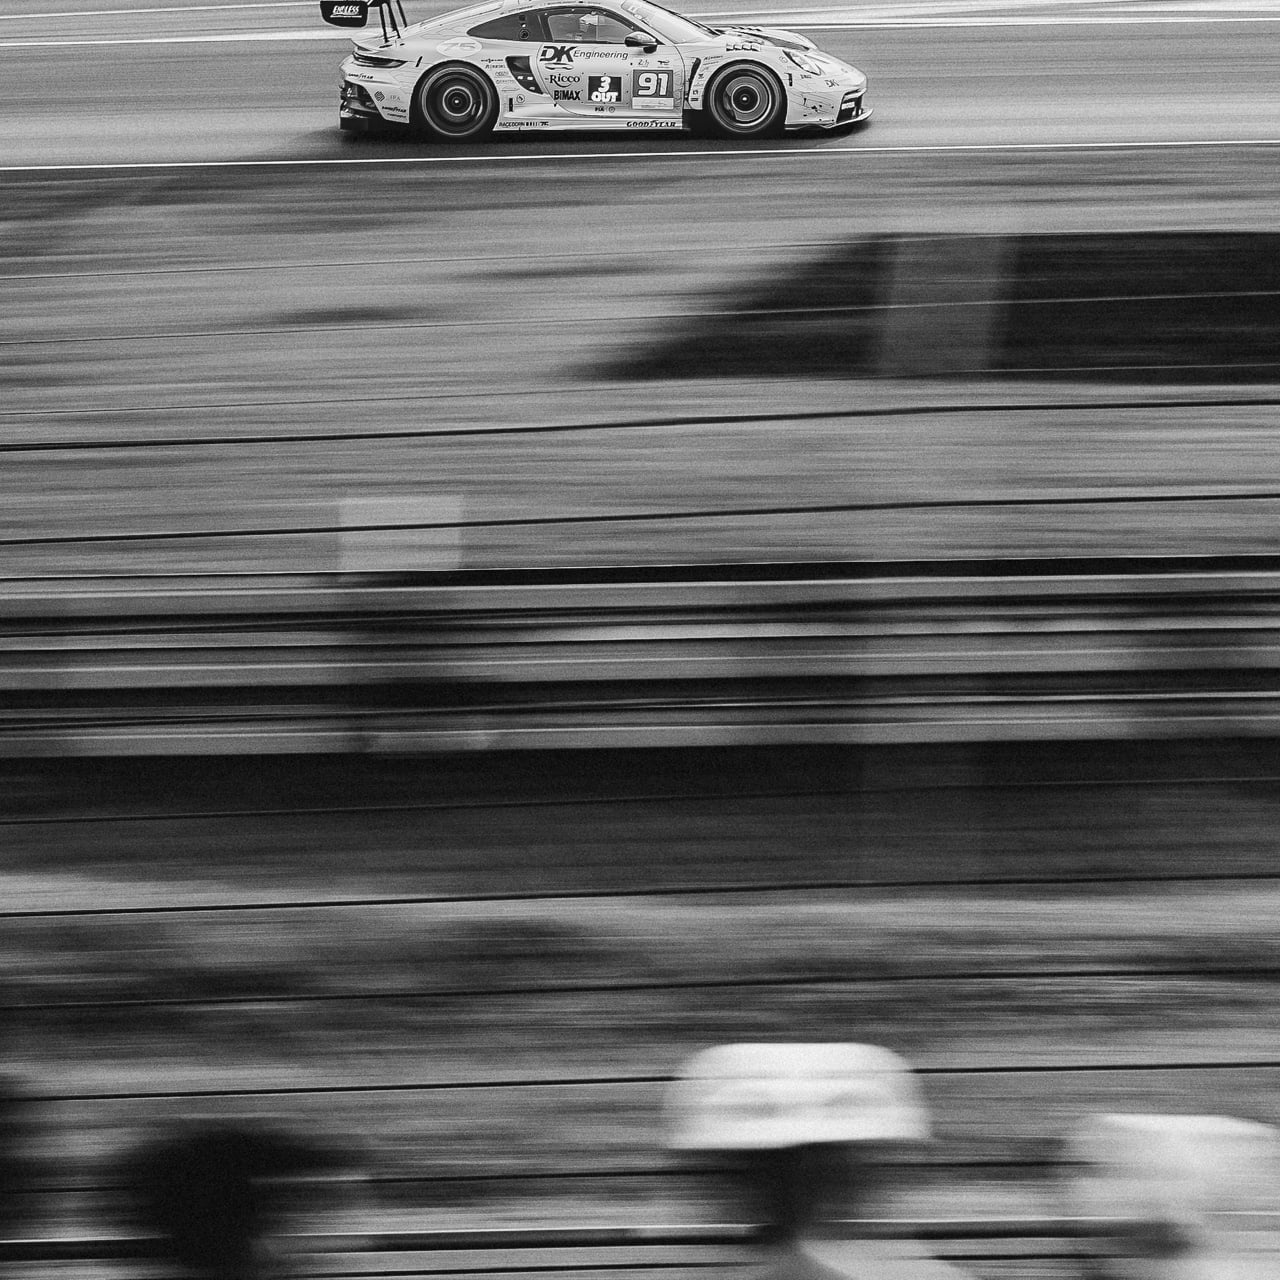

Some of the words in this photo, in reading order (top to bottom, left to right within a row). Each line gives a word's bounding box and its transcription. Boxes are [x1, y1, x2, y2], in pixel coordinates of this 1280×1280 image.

[539, 45, 577, 62] DK
[573, 49, 629, 60] Engineering
[549, 73, 580, 87] Ricco
[598, 76, 611, 92] 3
[637, 72, 669, 96] 91
[591, 91, 618, 102] OUT
[626, 120, 677, 128] GOODYEAR
